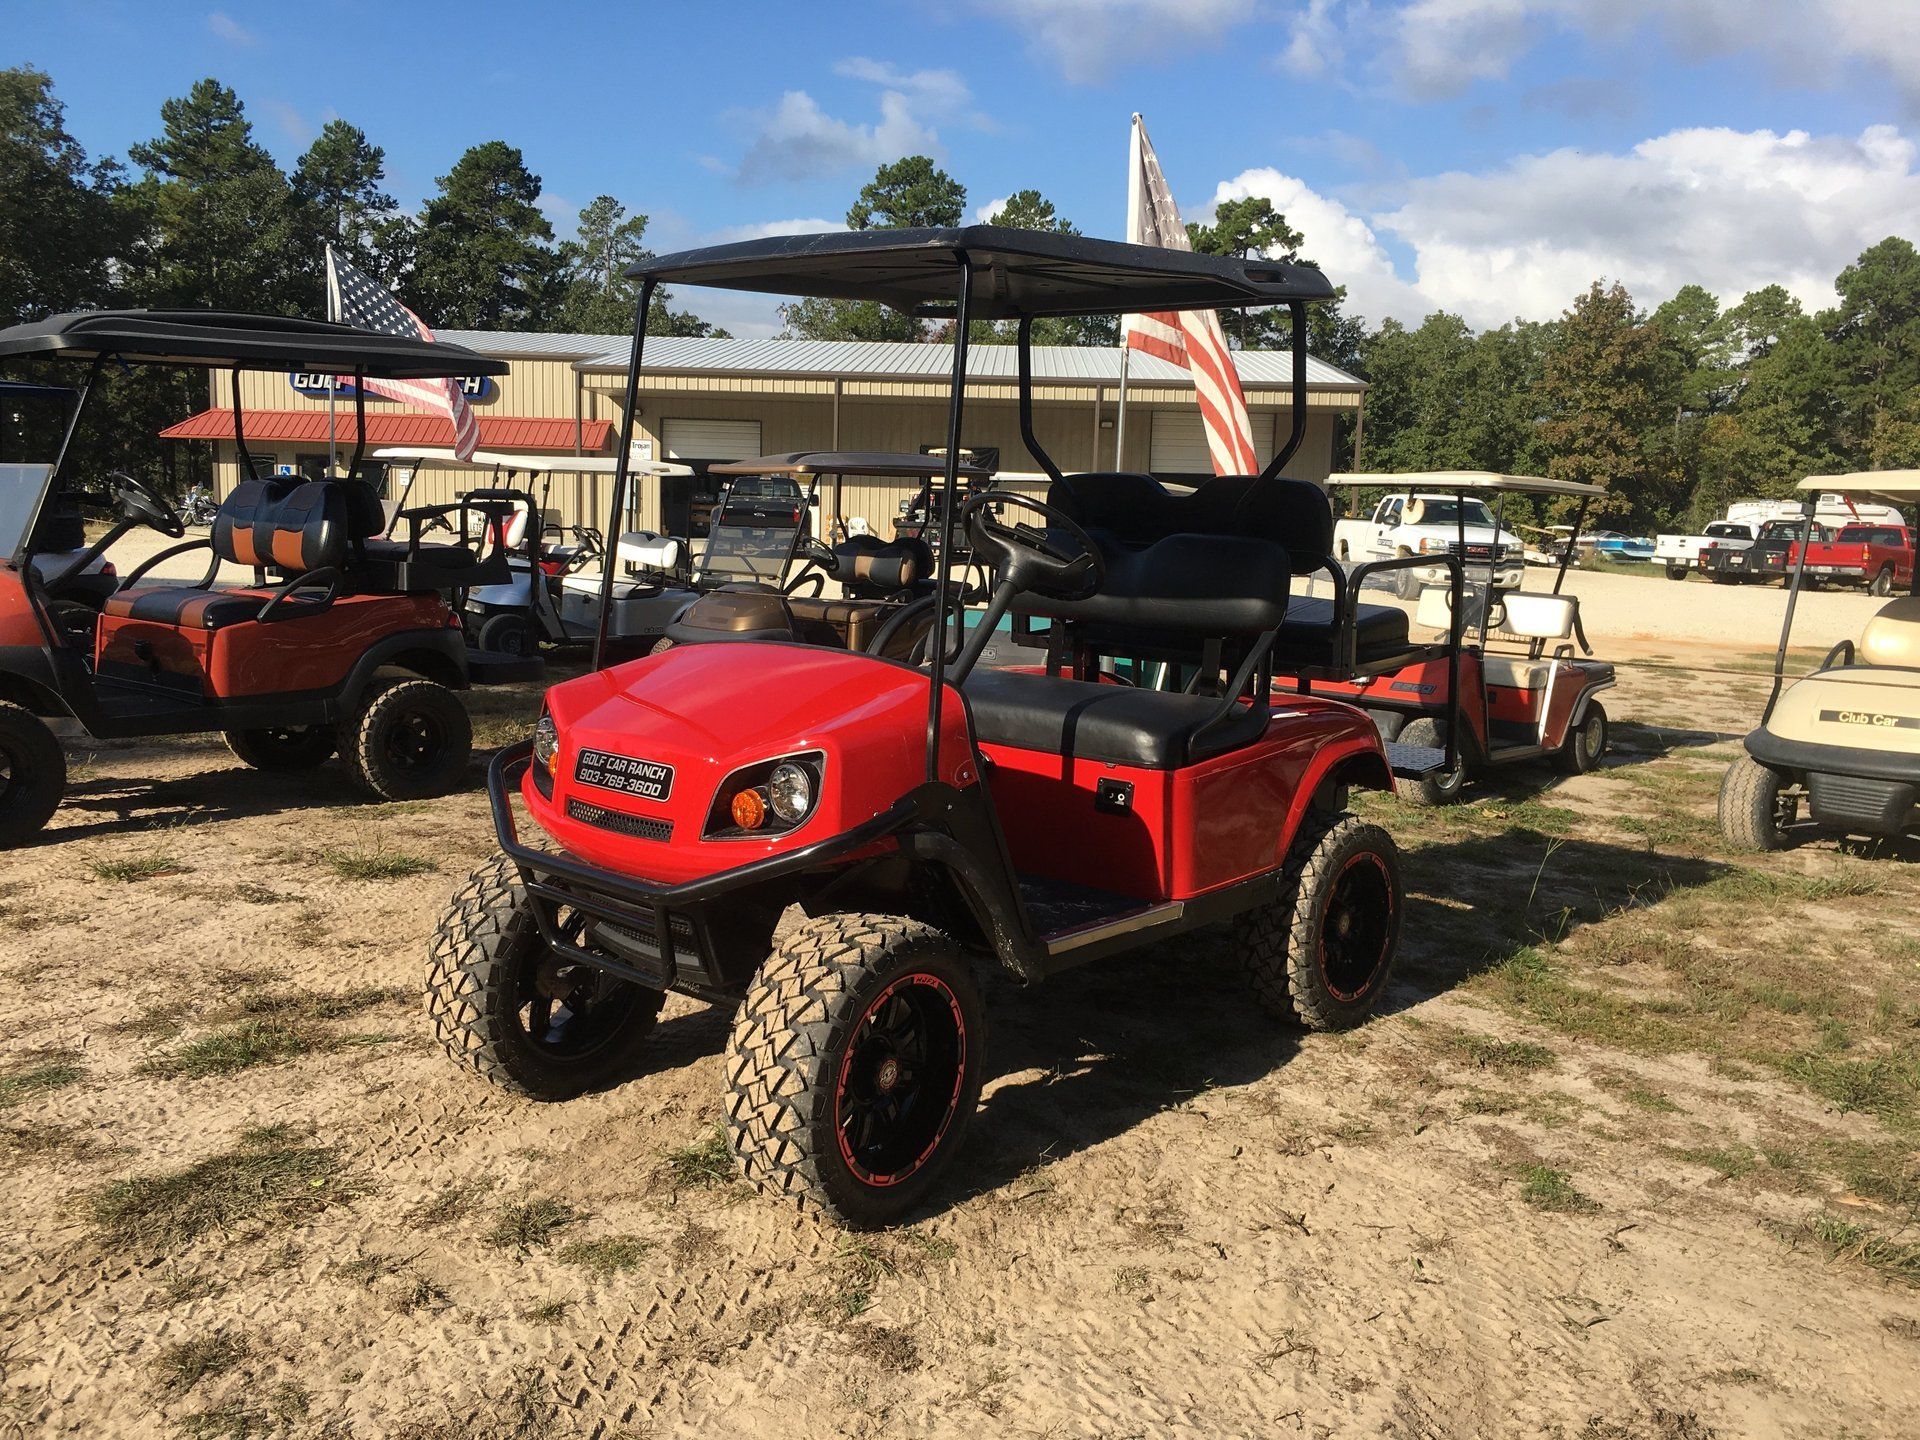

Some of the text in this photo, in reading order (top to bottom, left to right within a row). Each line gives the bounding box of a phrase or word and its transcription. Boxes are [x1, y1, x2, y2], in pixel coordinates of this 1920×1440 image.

[1839, 711, 1899, 727] Club Car
[582, 752, 667, 781] GOLF CAR RANCH
[579, 768, 662, 796] 903-769-3600
